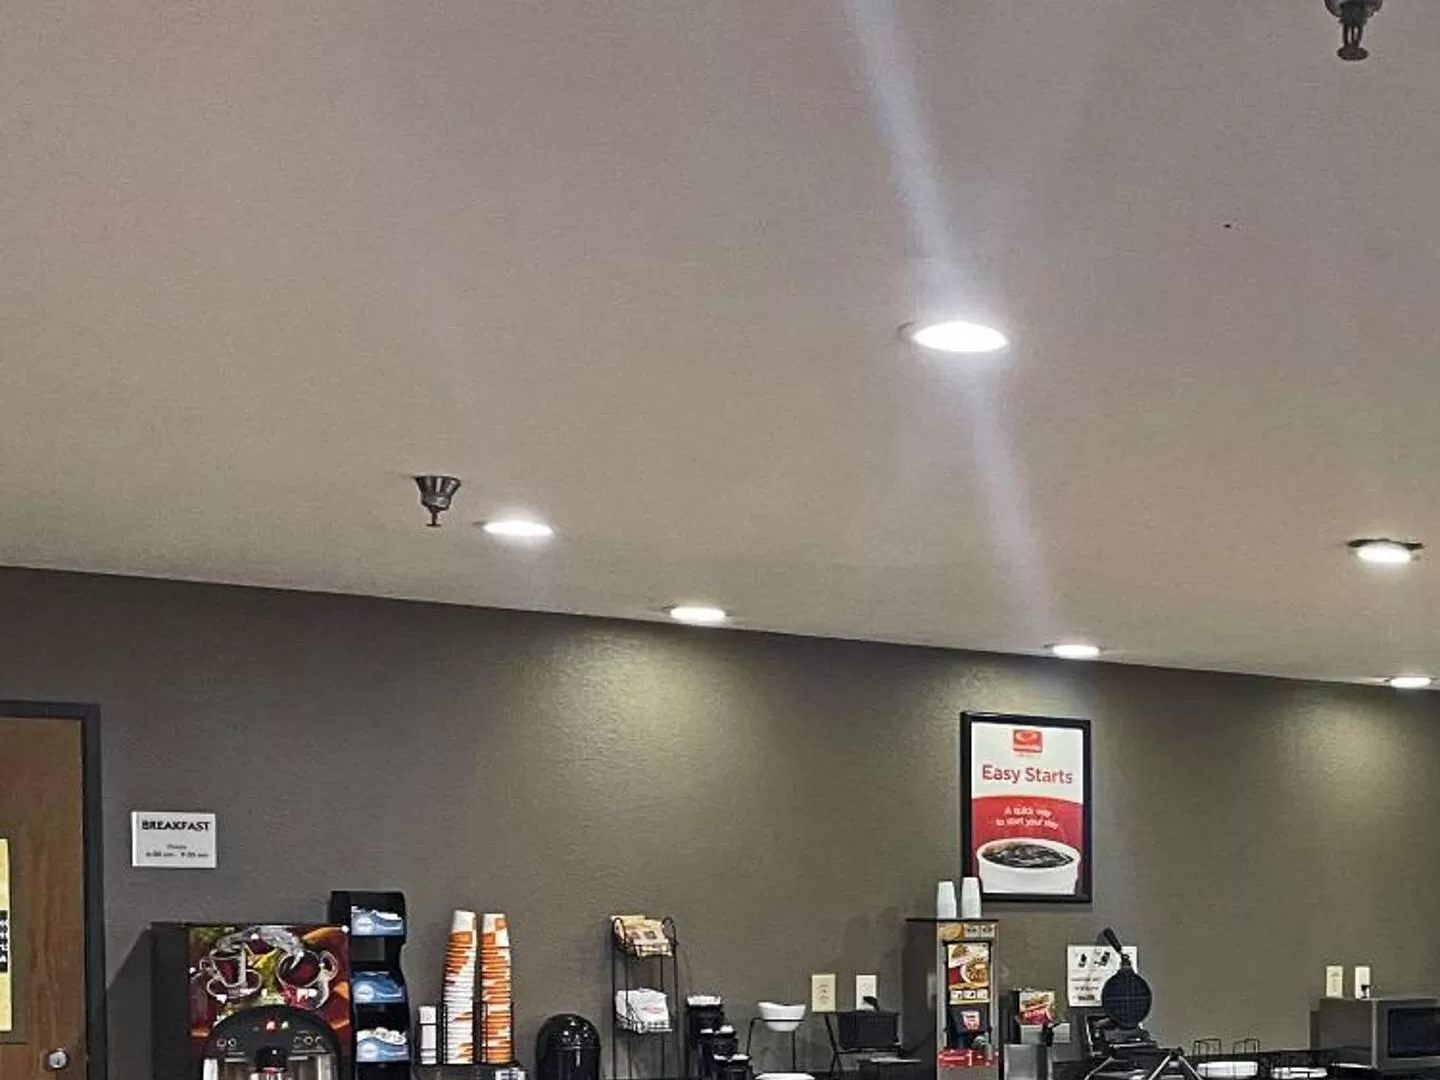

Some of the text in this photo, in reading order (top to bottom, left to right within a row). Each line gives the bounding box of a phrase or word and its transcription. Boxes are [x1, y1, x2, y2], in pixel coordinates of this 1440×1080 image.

[982, 764, 1073, 784] Easy Starts
[142, 820, 210, 831] BREAKFAST
